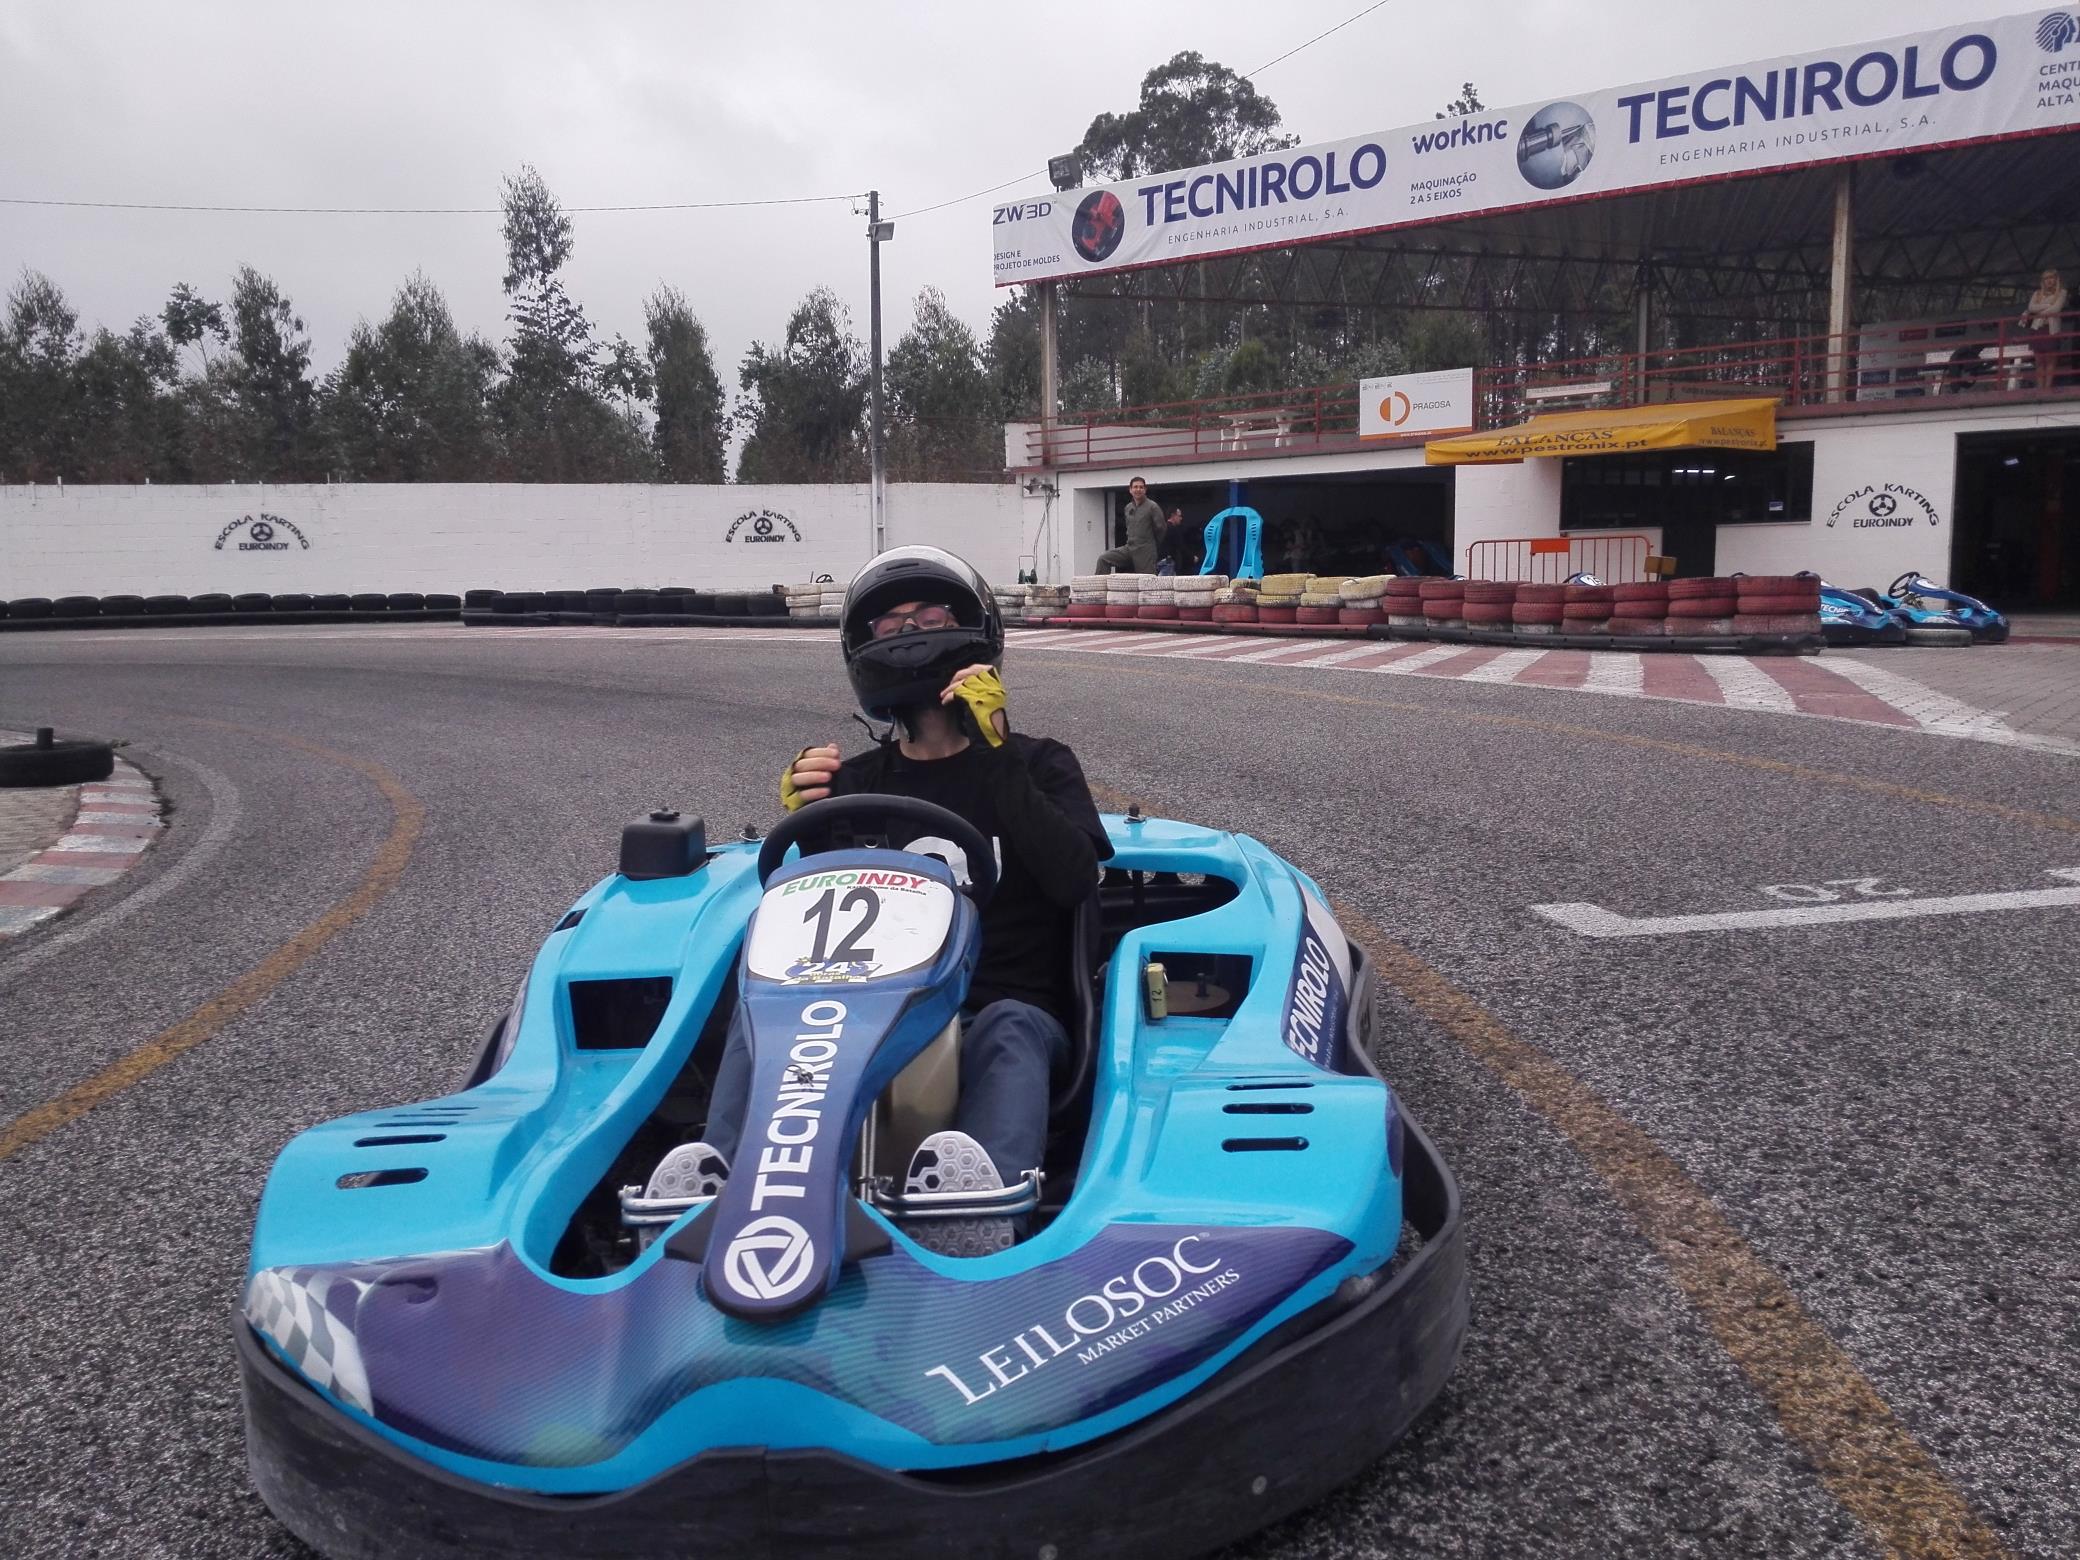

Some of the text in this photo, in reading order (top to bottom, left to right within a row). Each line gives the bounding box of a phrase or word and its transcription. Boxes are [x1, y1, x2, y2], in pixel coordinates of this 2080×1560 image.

[2040, 60, 2080, 76] CENT
[1617, 34, 1997, 144] TECNIROLO
[2037, 94, 2074, 108] ALTA
[1660, 139, 1766, 165] ENGENHARIA
[1776, 123, 1890, 147] INDUSTRIAL,
[1138, 143, 1387, 226] TECNIROLO
[1410, 172, 1477, 192] MAQUINAÇÃO
[1410, 188, 1462, 204] 2 A 5 EIXOS
[1168, 225, 1239, 244] ENGENHARIA
[1244, 212, 1318, 232] INDUSTRIAL,
[1033, 254, 1060, 266] MOLDES
[1412, 400, 1451, 411] PRAGOSA
[1465, 439, 1648, 459] www.pestronix.pt
[1496, 430, 1613, 447] BALANÇAS
[1826, 483, 1939, 528] ESCOLA KARTING
[214, 513, 310, 550] ESCOLA KARTING
[725, 509, 802, 543] ESCOLA KARTING
[1853, 517, 1914, 528] EUROINDY
[239, 543, 289, 551] EUROINDY
[744, 535, 785, 543] EUROINDY
[782, 873, 927, 897] EUROINDY
[803, 887, 881, 962] 12
[1151, 989, 1163, 1002] 12
[1289, 937, 1330, 1061] ECNIROLO
[750, 1000, 847, 1211] TECNIROLO
[924, 1235, 1222, 1405] LEILOSOC
[1077, 1268, 1240, 1366] MARKET PARTNERS
